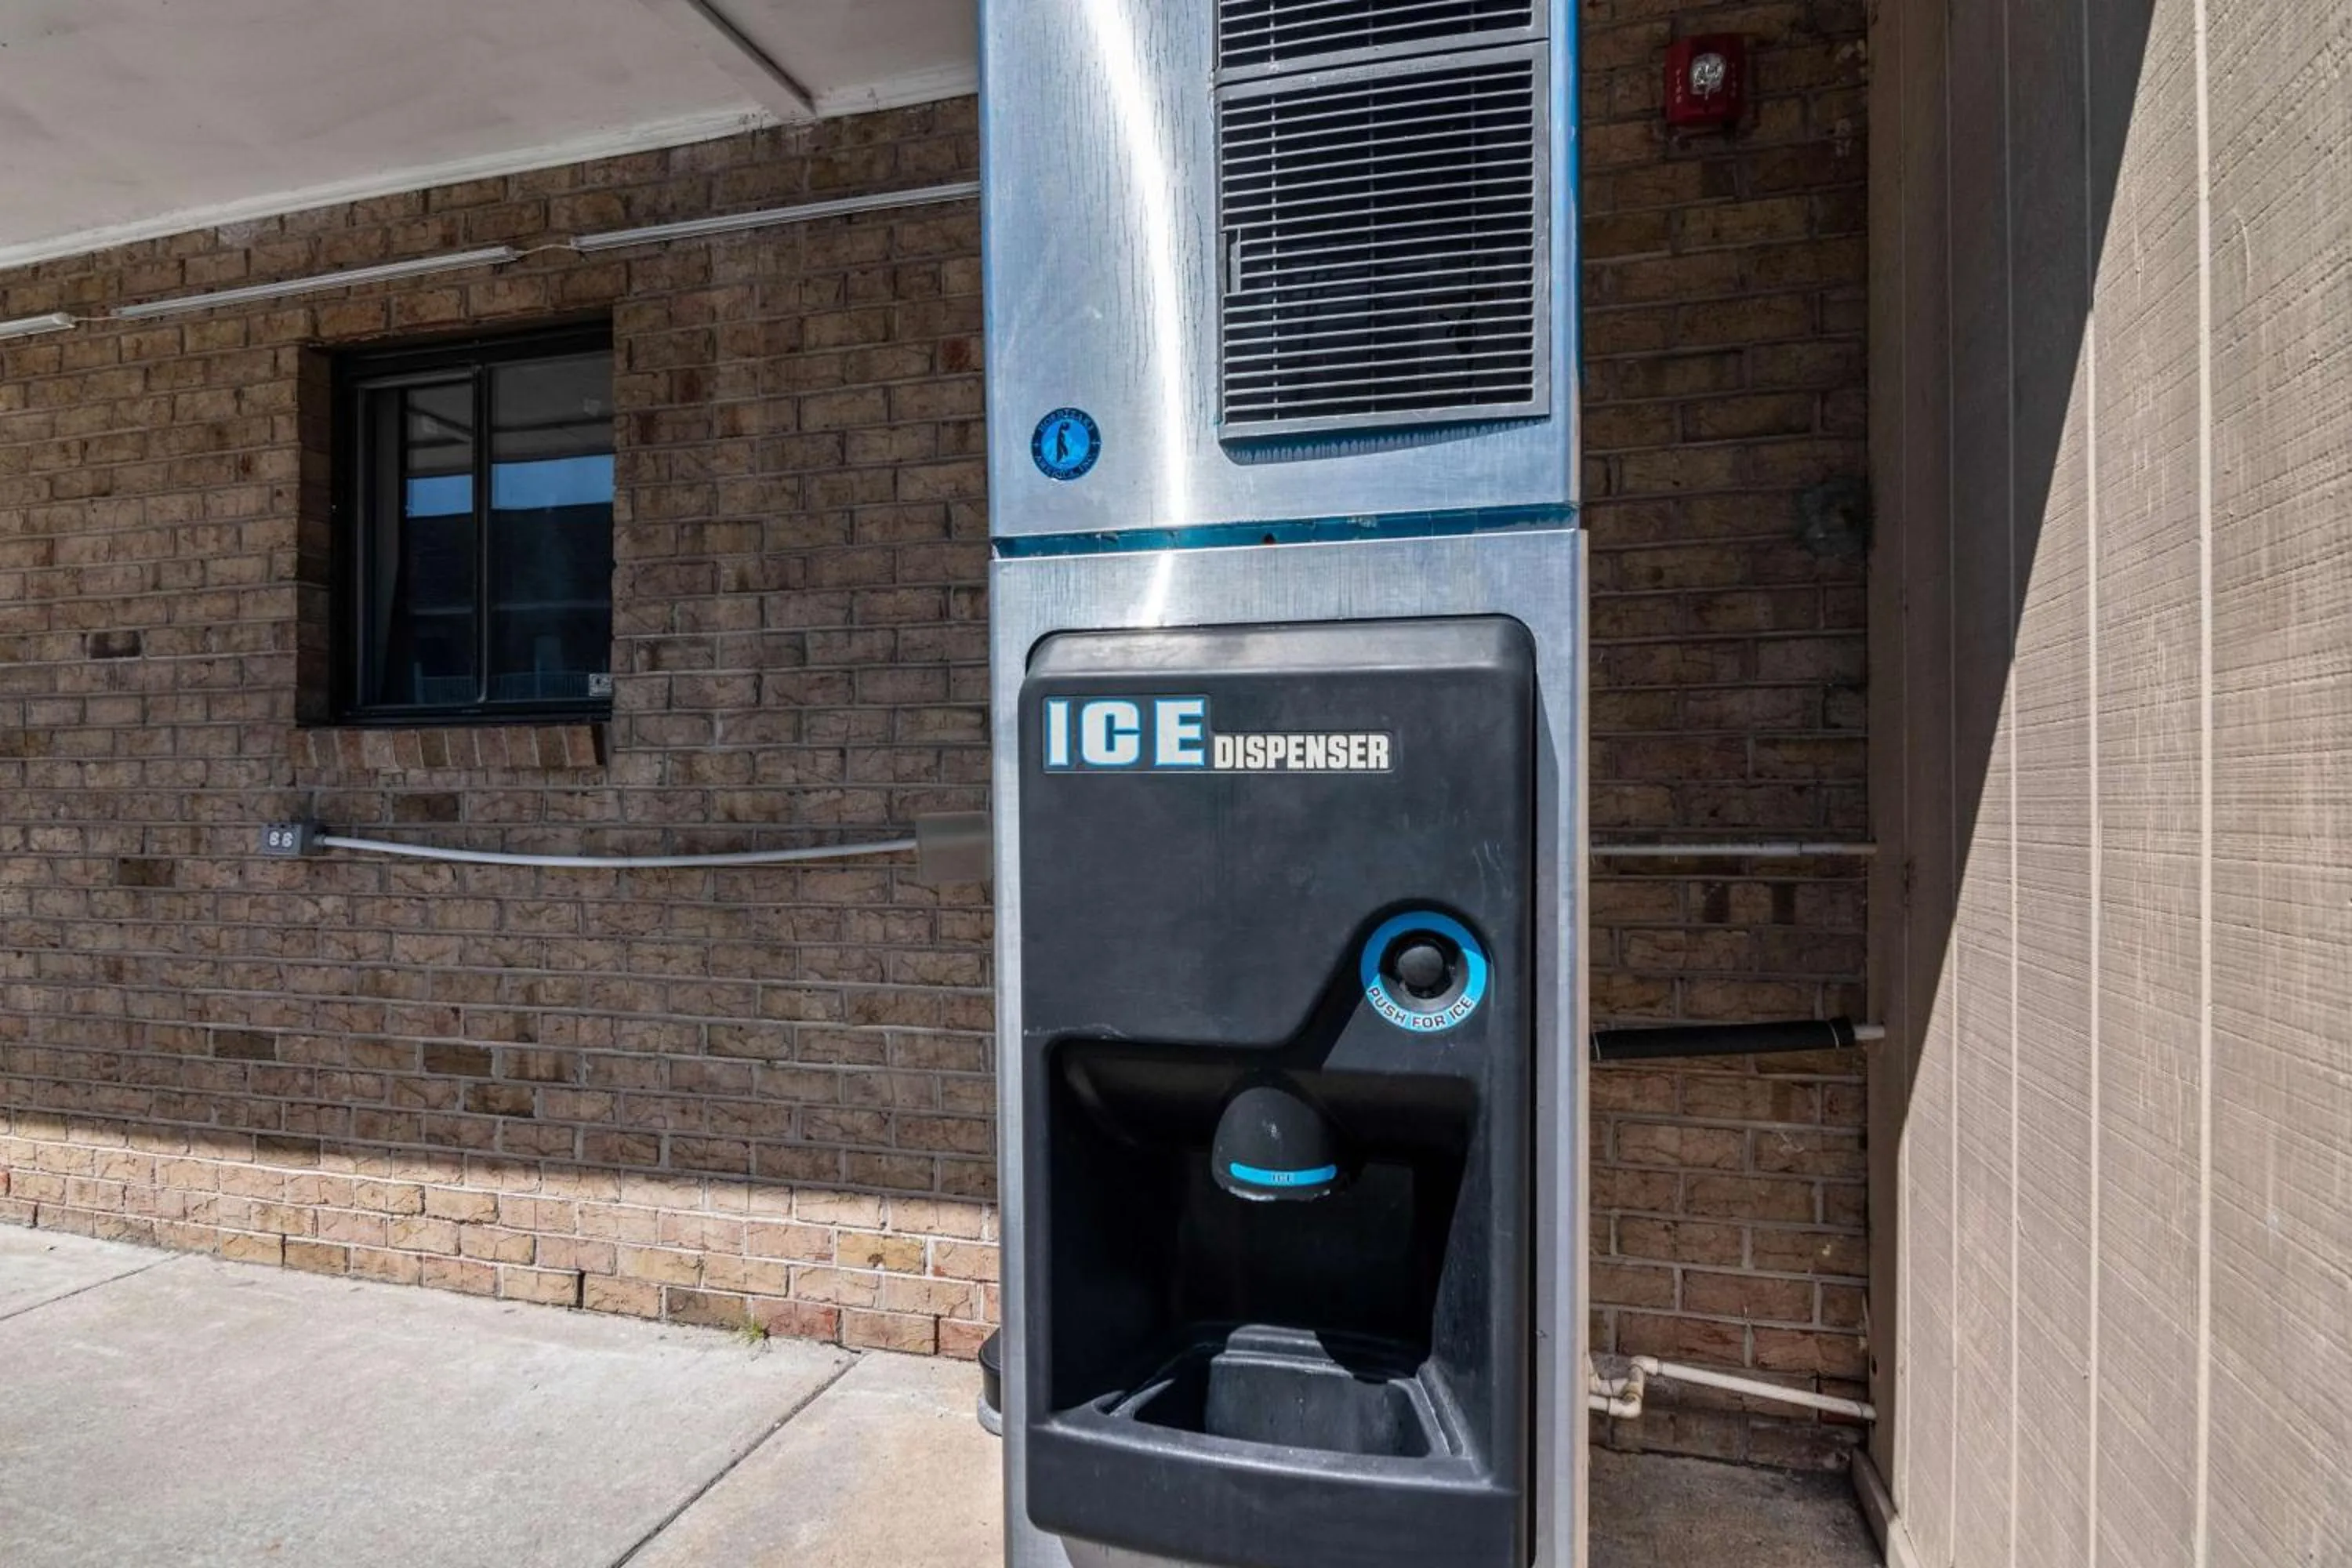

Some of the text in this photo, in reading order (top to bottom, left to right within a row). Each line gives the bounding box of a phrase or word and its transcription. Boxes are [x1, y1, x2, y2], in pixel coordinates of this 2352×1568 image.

[1047, 700, 1389, 770] ICE DISPENSER
[1368, 987, 1473, 1028] PUSH FOR ICE
